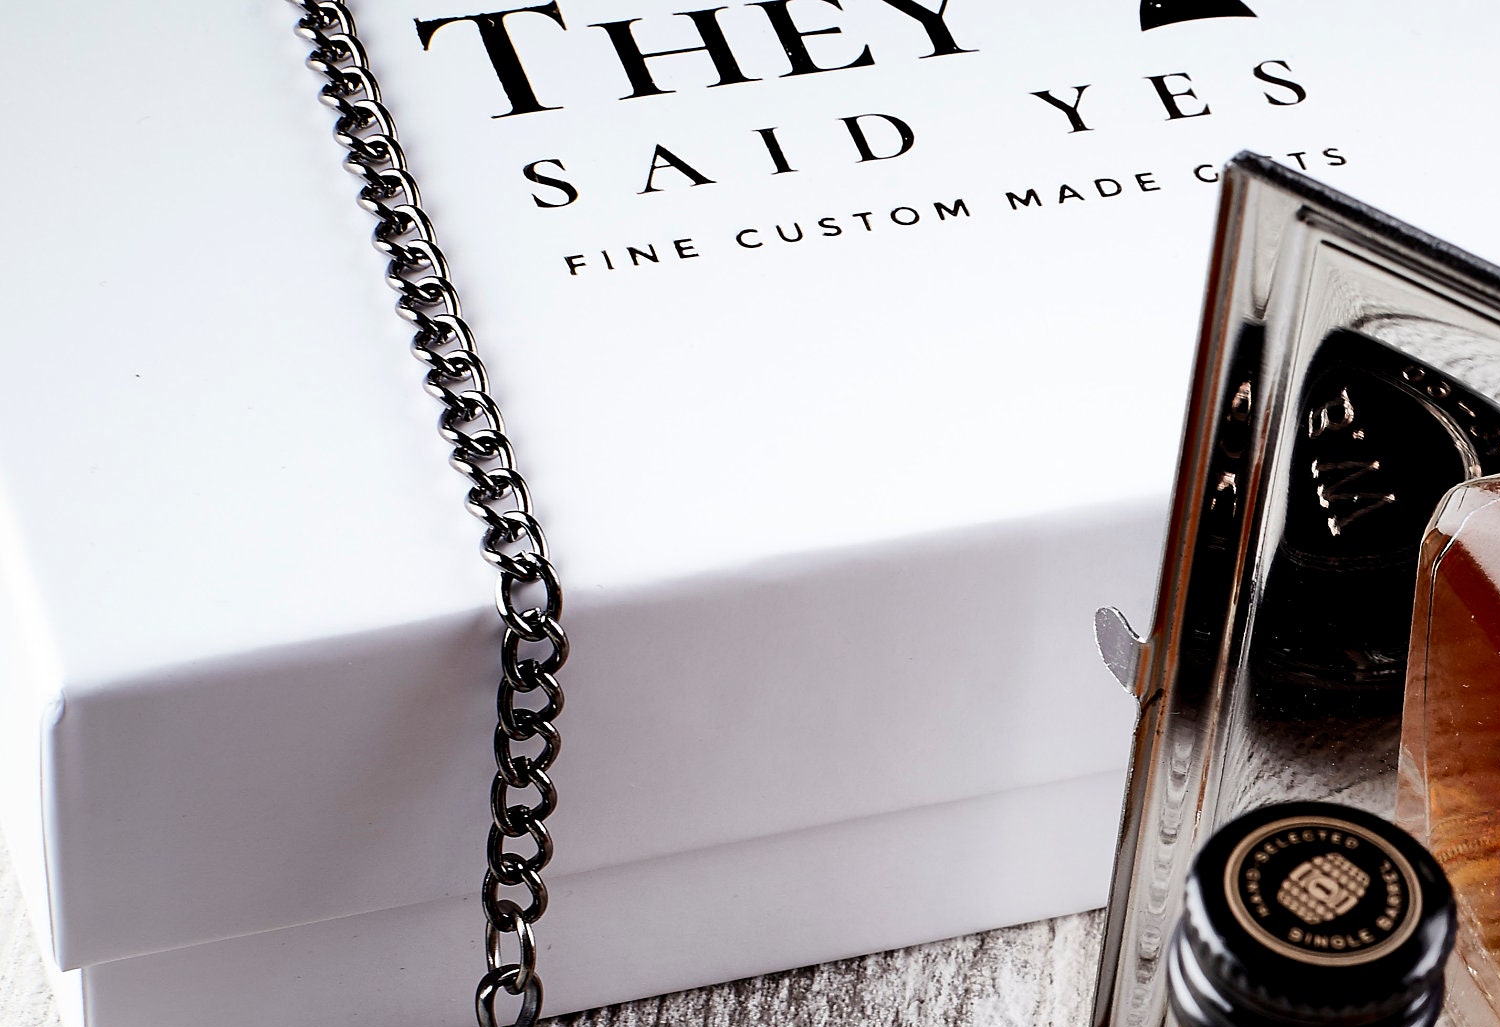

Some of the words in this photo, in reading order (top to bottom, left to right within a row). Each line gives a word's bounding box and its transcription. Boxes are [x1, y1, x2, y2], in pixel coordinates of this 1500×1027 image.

[413, 0, 979, 120] THEY
[521, 112, 916, 210] SAID
[1029, 58, 1308, 134] YES
[563, 237, 701, 278] FINE
[736, 197, 971, 250] CUSTOM
[1005, 171, 1161, 212] MADE
[1193, 148, 1347, 183] GTS
